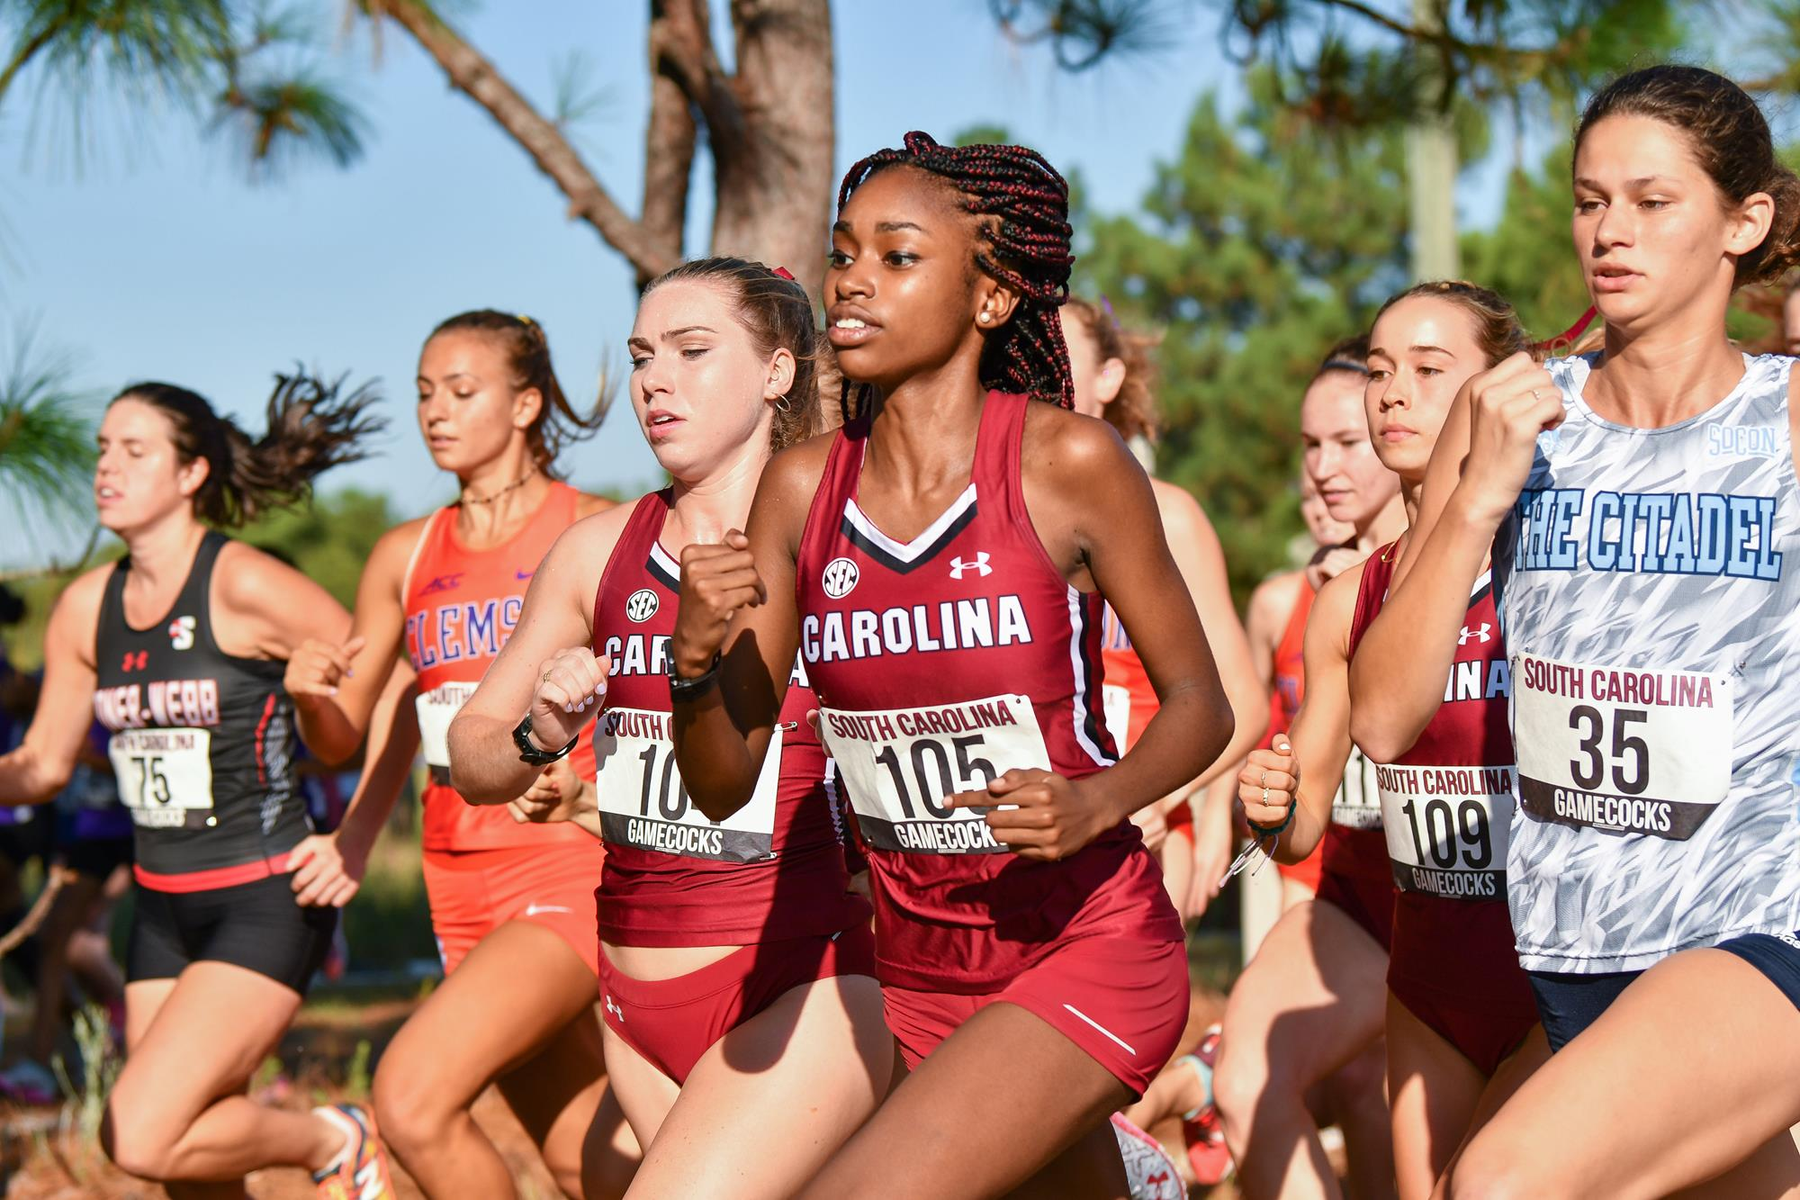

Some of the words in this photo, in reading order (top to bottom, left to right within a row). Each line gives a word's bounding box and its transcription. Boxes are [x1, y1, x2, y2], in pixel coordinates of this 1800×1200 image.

[1586, 490, 1783, 581] CITADEL
[825, 560, 857, 596] SEC
[628, 592, 657, 619] SEC
[803, 594, 1033, 664] CAROLINA
[1523, 657, 1584, 701] SOUTH
[1591, 671, 1714, 709] CAROLINA
[605, 710, 663, 741] SOUTH
[828, 712, 898, 743] SOUTH
[900, 700, 1018, 735] CAROLINA
[1569, 705, 1649, 796] 35
[131, 757, 171, 804] 75
[638, 743, 722, 827] 10
[875, 734, 1005, 820] 105
[1376, 766, 1420, 795] SOUTH
[1423, 769, 1512, 796] CAROLINA
[1554, 787, 1671, 833] GAMECOCKS
[627, 818, 723, 855] GAMECOCKS
[894, 820, 1005, 850] GAMECOCK
[1402, 798, 1493, 870] 109
[1411, 867, 1496, 896] GAMECOCKS
